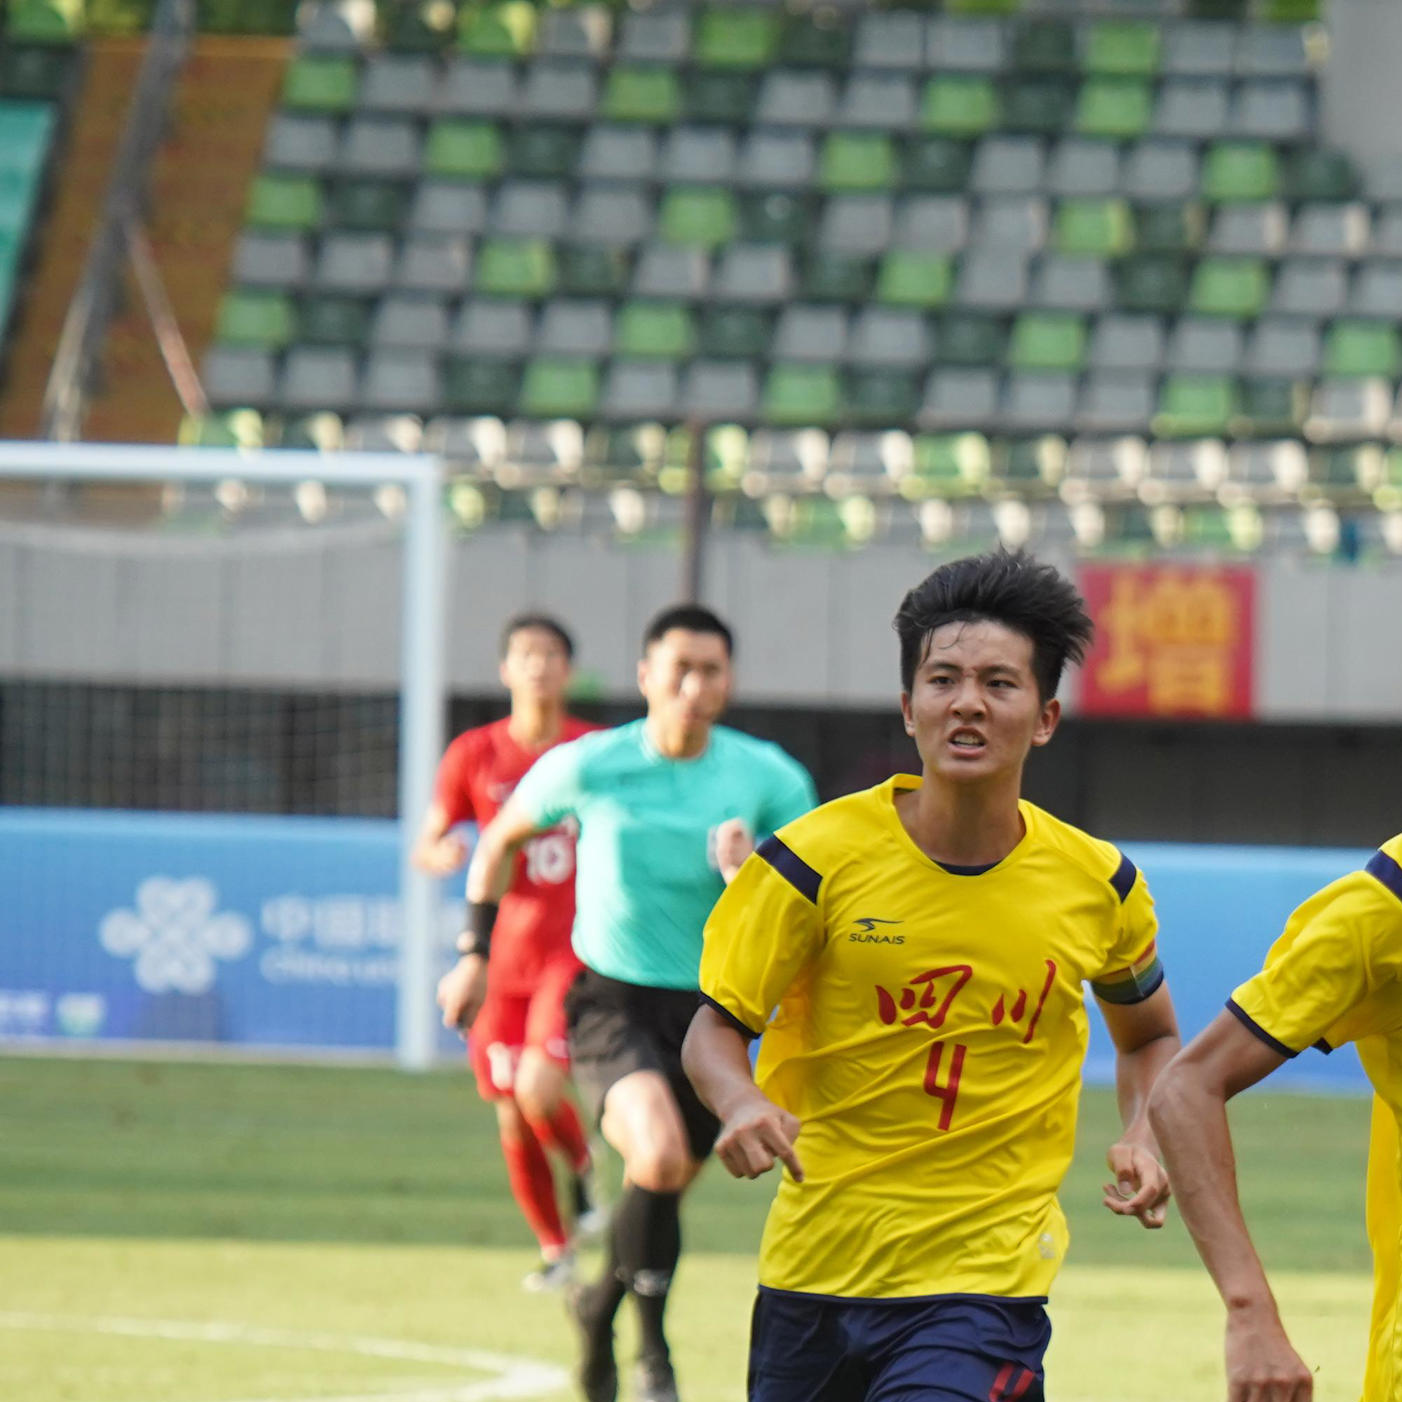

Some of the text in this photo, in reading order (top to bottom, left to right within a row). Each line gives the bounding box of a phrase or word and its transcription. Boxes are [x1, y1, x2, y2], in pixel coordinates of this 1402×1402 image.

[1098, 572, 1234, 716] 增
[848, 932, 905, 945] SUNAIS
[874, 959, 1057, 1045] 四川
[923, 1041, 968, 1132] 4
